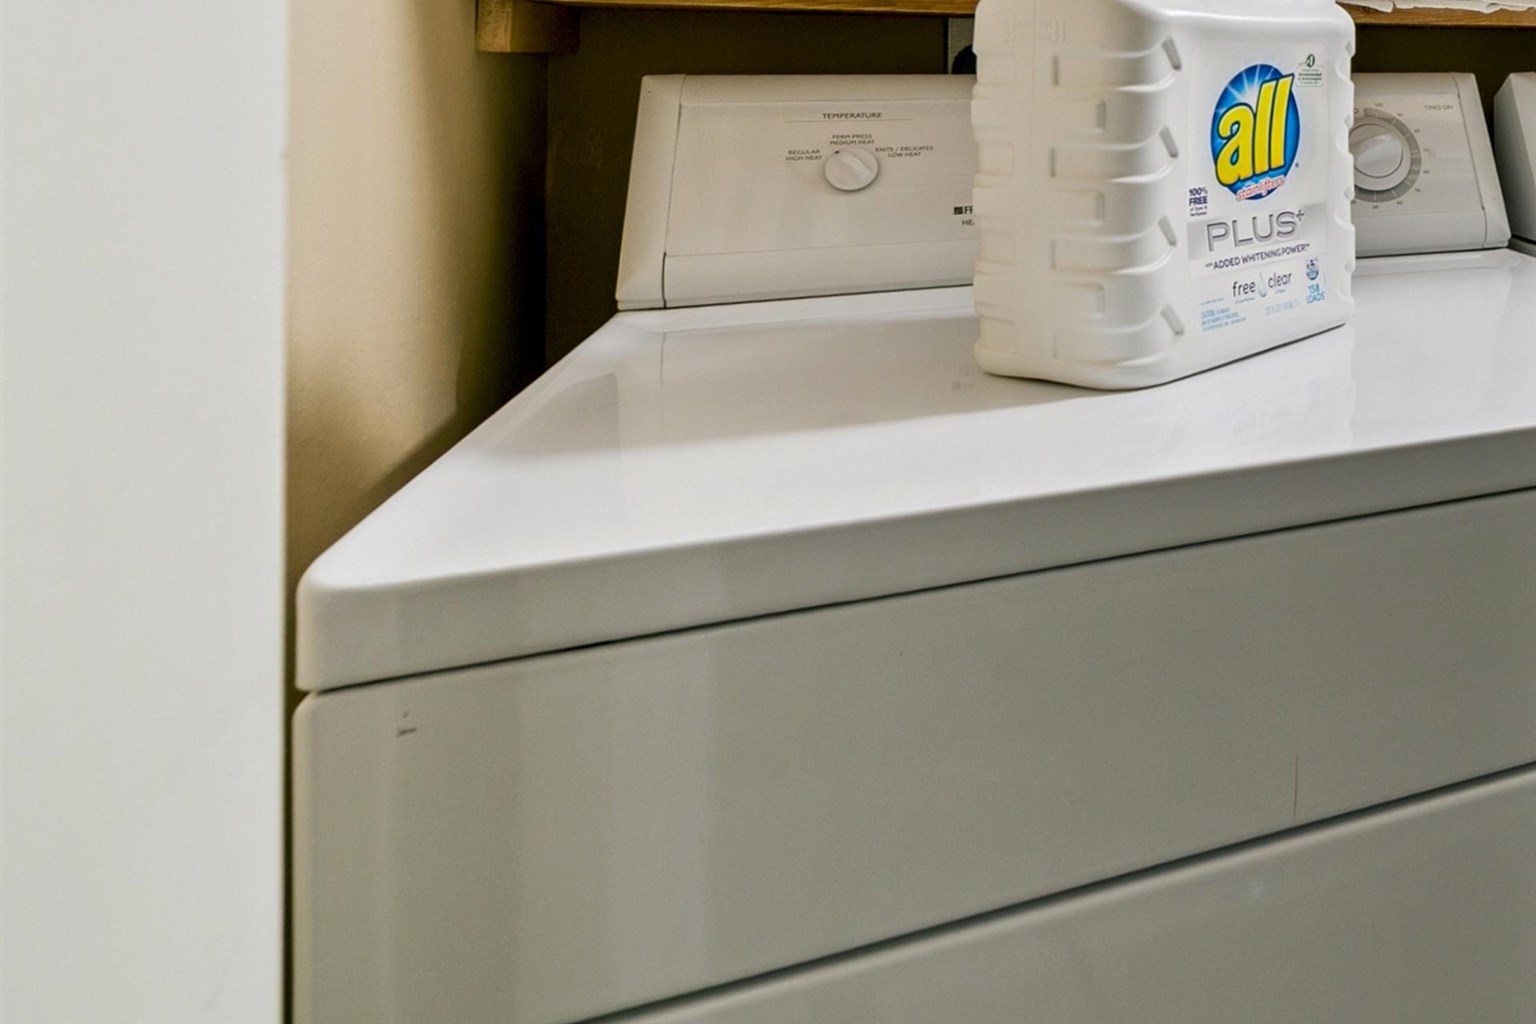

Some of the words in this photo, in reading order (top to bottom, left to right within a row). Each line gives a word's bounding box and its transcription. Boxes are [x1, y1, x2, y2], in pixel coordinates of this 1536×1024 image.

[822, 112, 882, 120] TEMPERATURE
[1215, 73, 1295, 187] all
[1189, 195, 1208, 206] FREE
[1213, 256, 1241, 270] ADDED
[1241, 248, 1281, 265] WHITENING
[1232, 280, 1256, 297] free
[1268, 272, 1292, 289] clear
